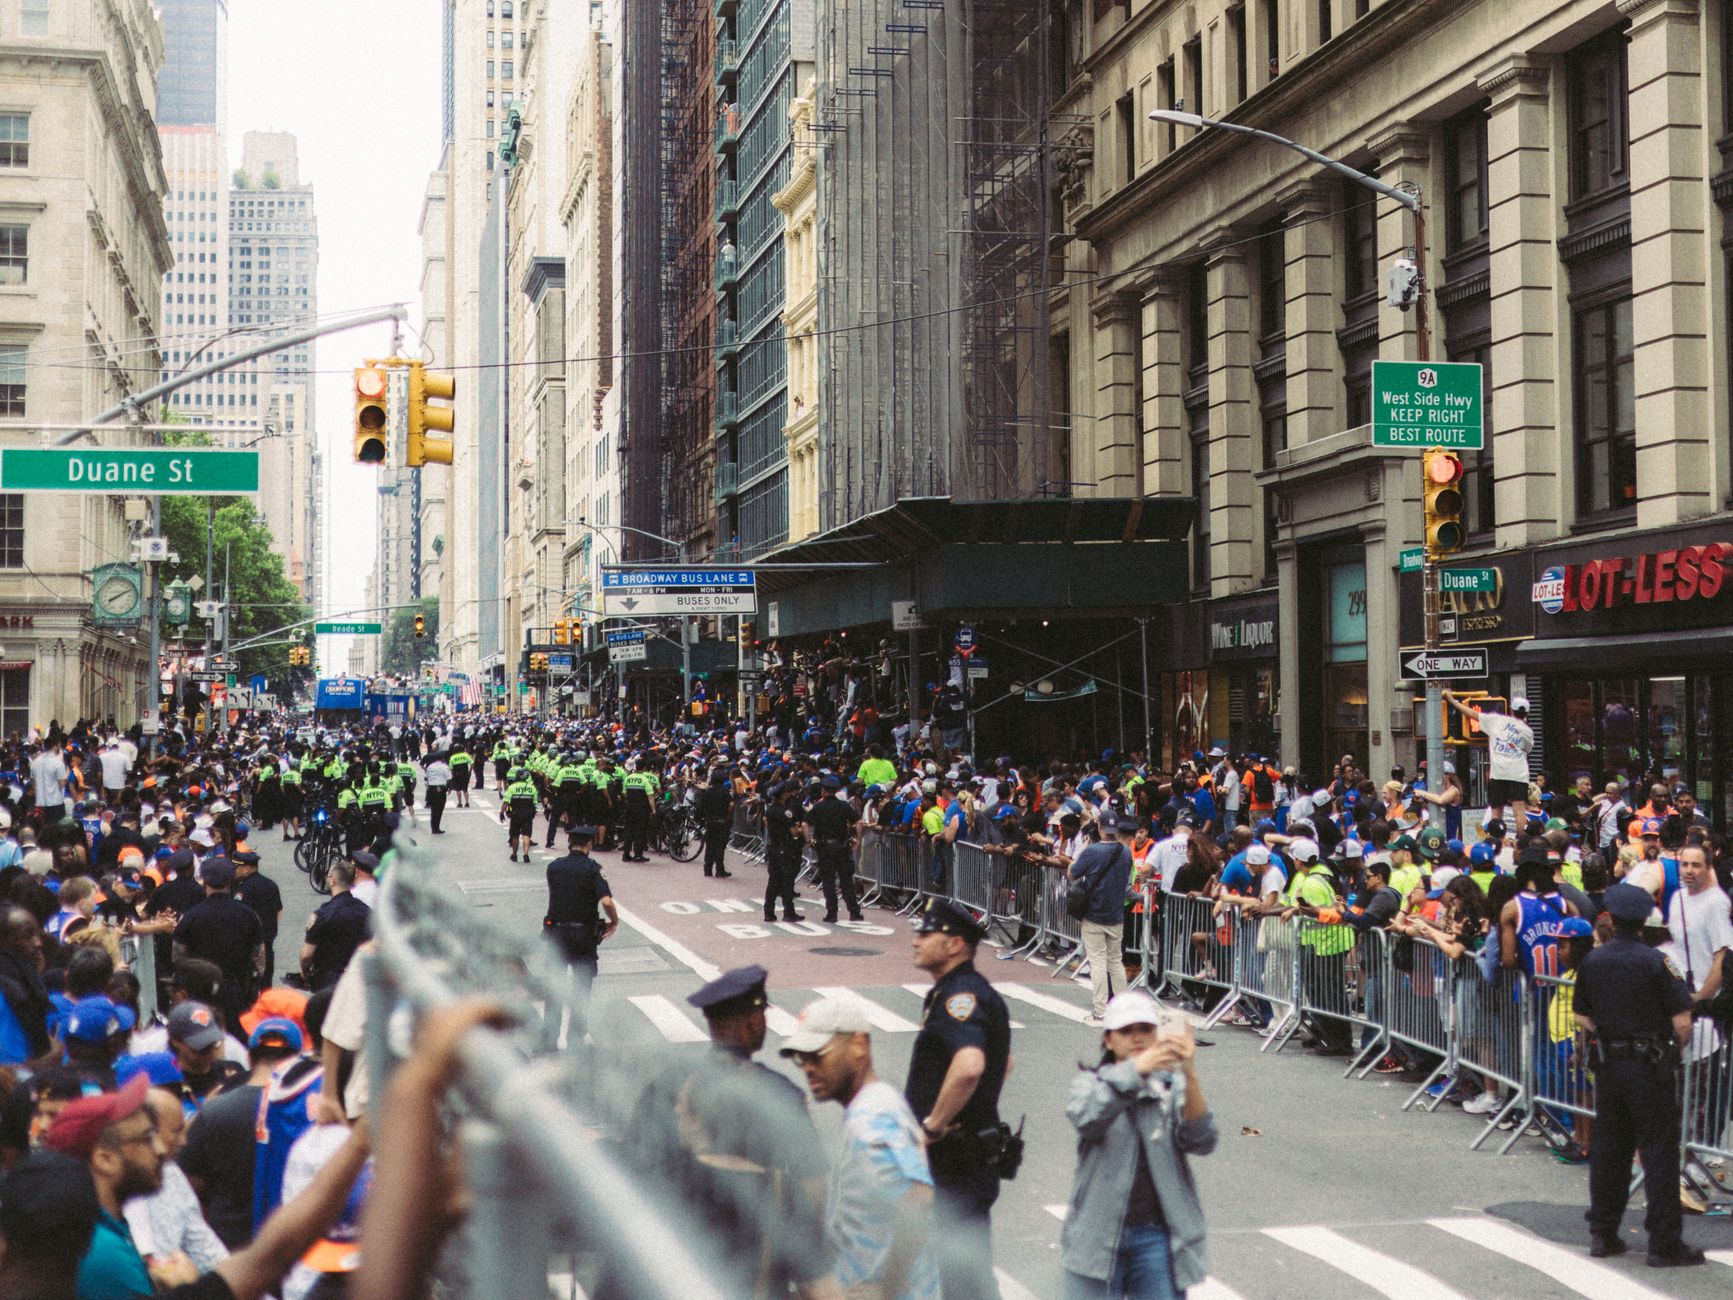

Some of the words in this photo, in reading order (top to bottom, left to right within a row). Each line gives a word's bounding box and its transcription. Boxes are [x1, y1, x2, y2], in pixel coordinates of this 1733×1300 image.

[1420, 372, 1435, 384] 9A
[1382, 391, 1409, 404] West
[1414, 392, 1440, 405] Side
[1445, 393, 1473, 409] Hwy
[1391, 408, 1423, 422] KEEP
[1428, 410, 1465, 423] RIGHT
[1390, 427, 1420, 441] BEST
[1425, 429, 1466, 442] ROUTE
[68, 458, 155, 482] Duane
[168, 459, 193, 482] St
[622, 574, 678, 584] BROADWAY
[681, 574, 703, 583] BUS
[706, 573, 735, 583] LANE
[1444, 572, 1478, 588] Duane
[1482, 571, 1489, 581] St
[1563, 543, 1724, 612] LOT-LESS
[677, 597, 711, 606] BUSES
[714, 597, 740, 605] ONLY
[332, 625, 355, 633] Reade
[1417, 660, 1440, 671] ONE
[1452, 658, 1477, 669] WAY
[565, 769, 580, 777] NYPD
[366, 791, 385, 799] NYPD
[515, 786, 533, 794] NYPD
[1171, 844, 1187, 852] NYP
[716, 920, 895, 940] BUS
[1523, 921, 1557, 946] BRUNS
[1532, 945, 1557, 986] 11
